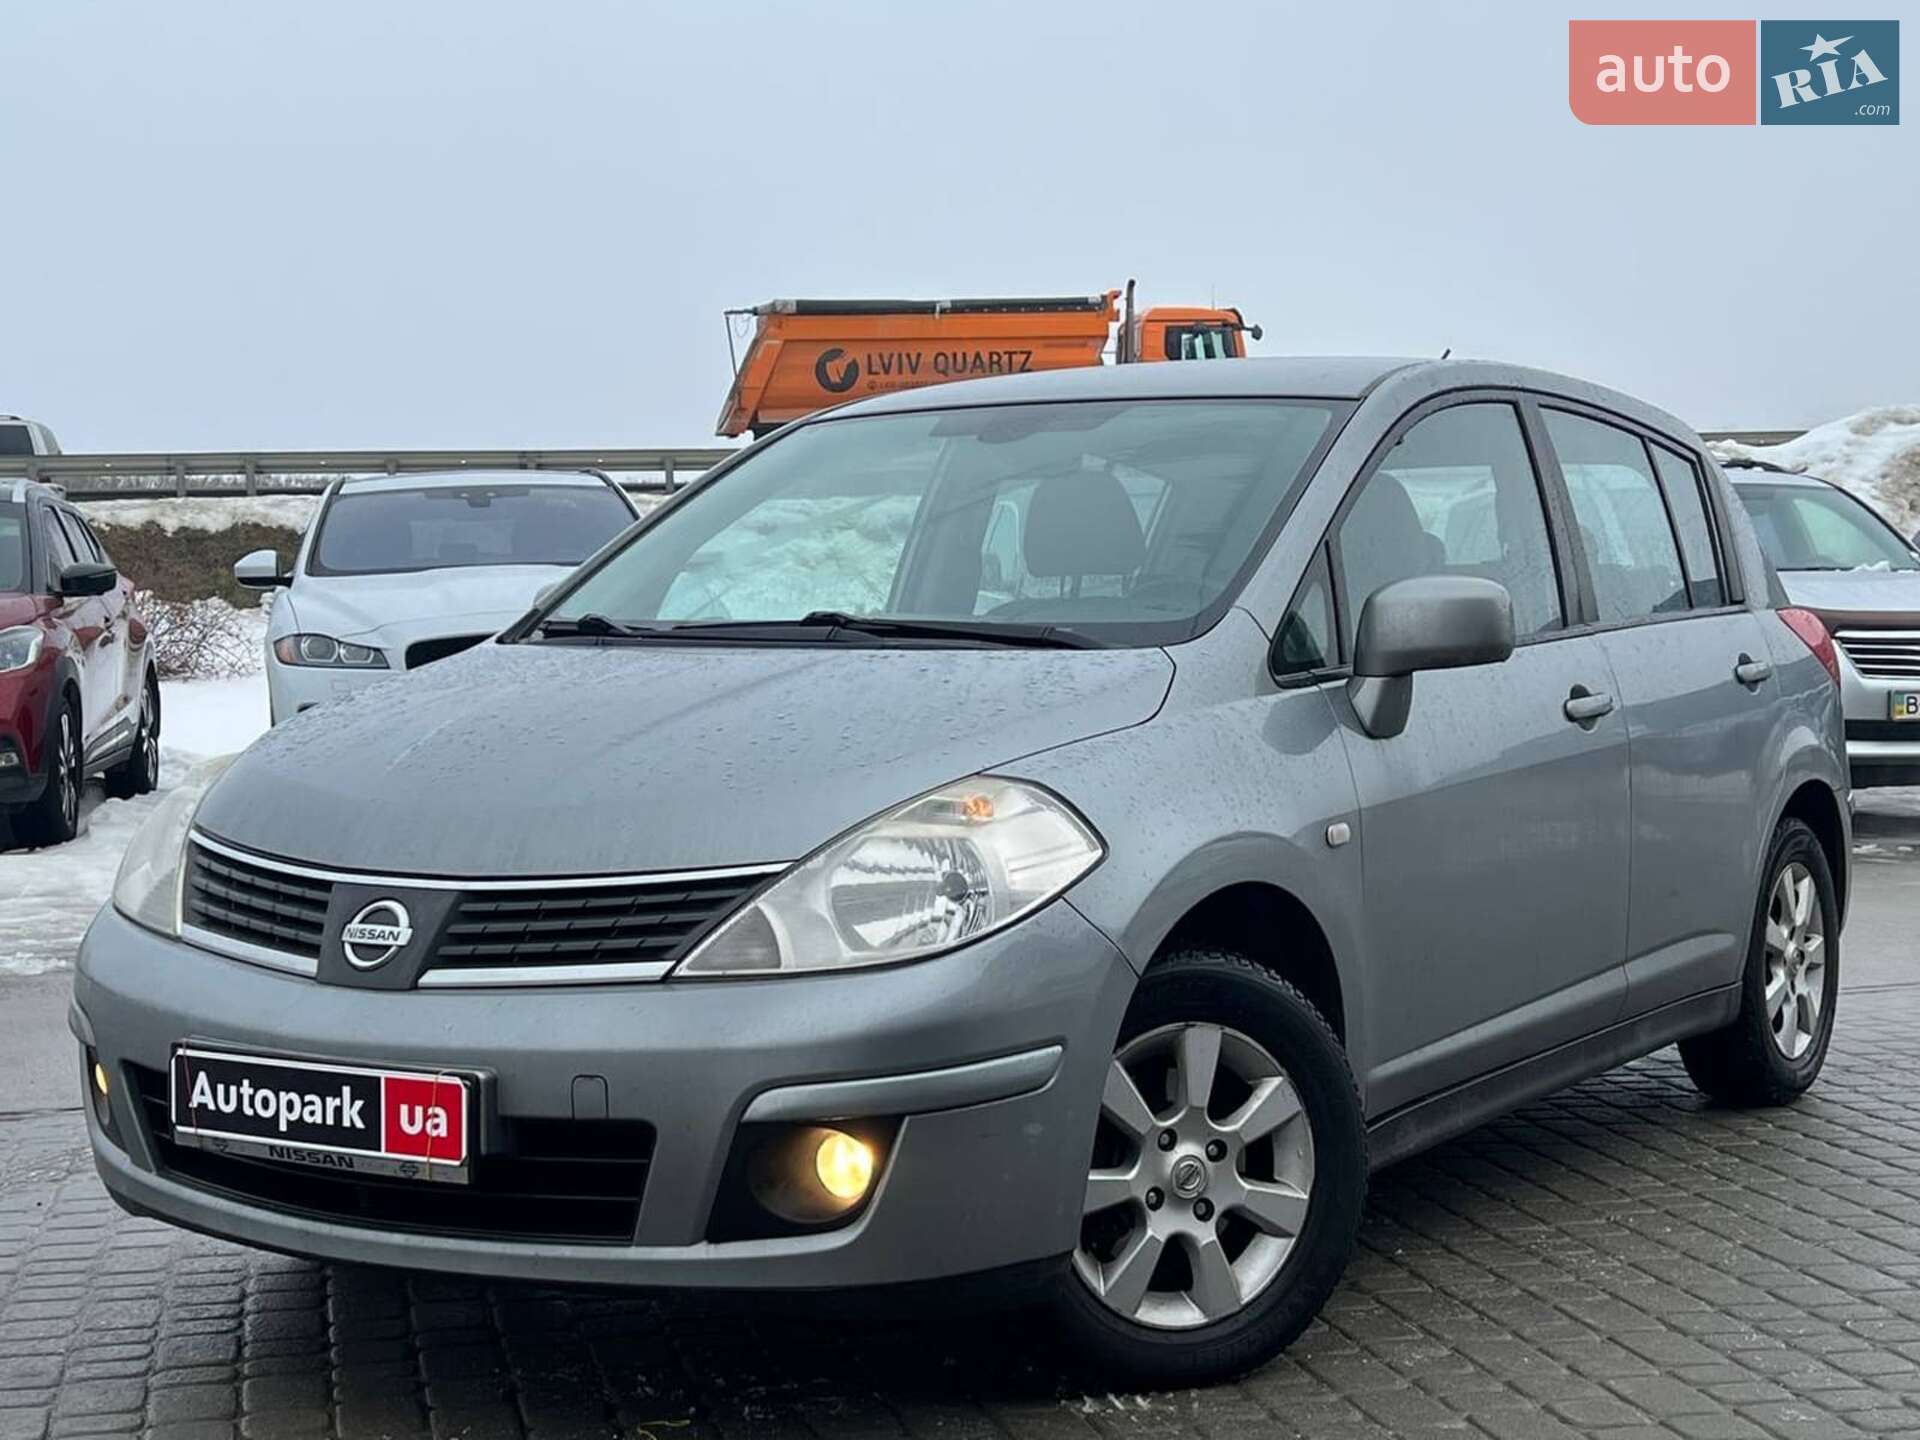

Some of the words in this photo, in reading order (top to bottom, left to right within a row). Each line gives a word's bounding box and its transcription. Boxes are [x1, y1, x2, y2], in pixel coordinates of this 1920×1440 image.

[866, 352, 922, 375] LVIV
[933, 350, 1034, 377] QUARTZ
[345, 927, 401, 942] NISSAN
[189, 1071, 366, 1132] Autopark
[399, 1103, 448, 1138] ua
[268, 1146, 355, 1169] NISSAN
